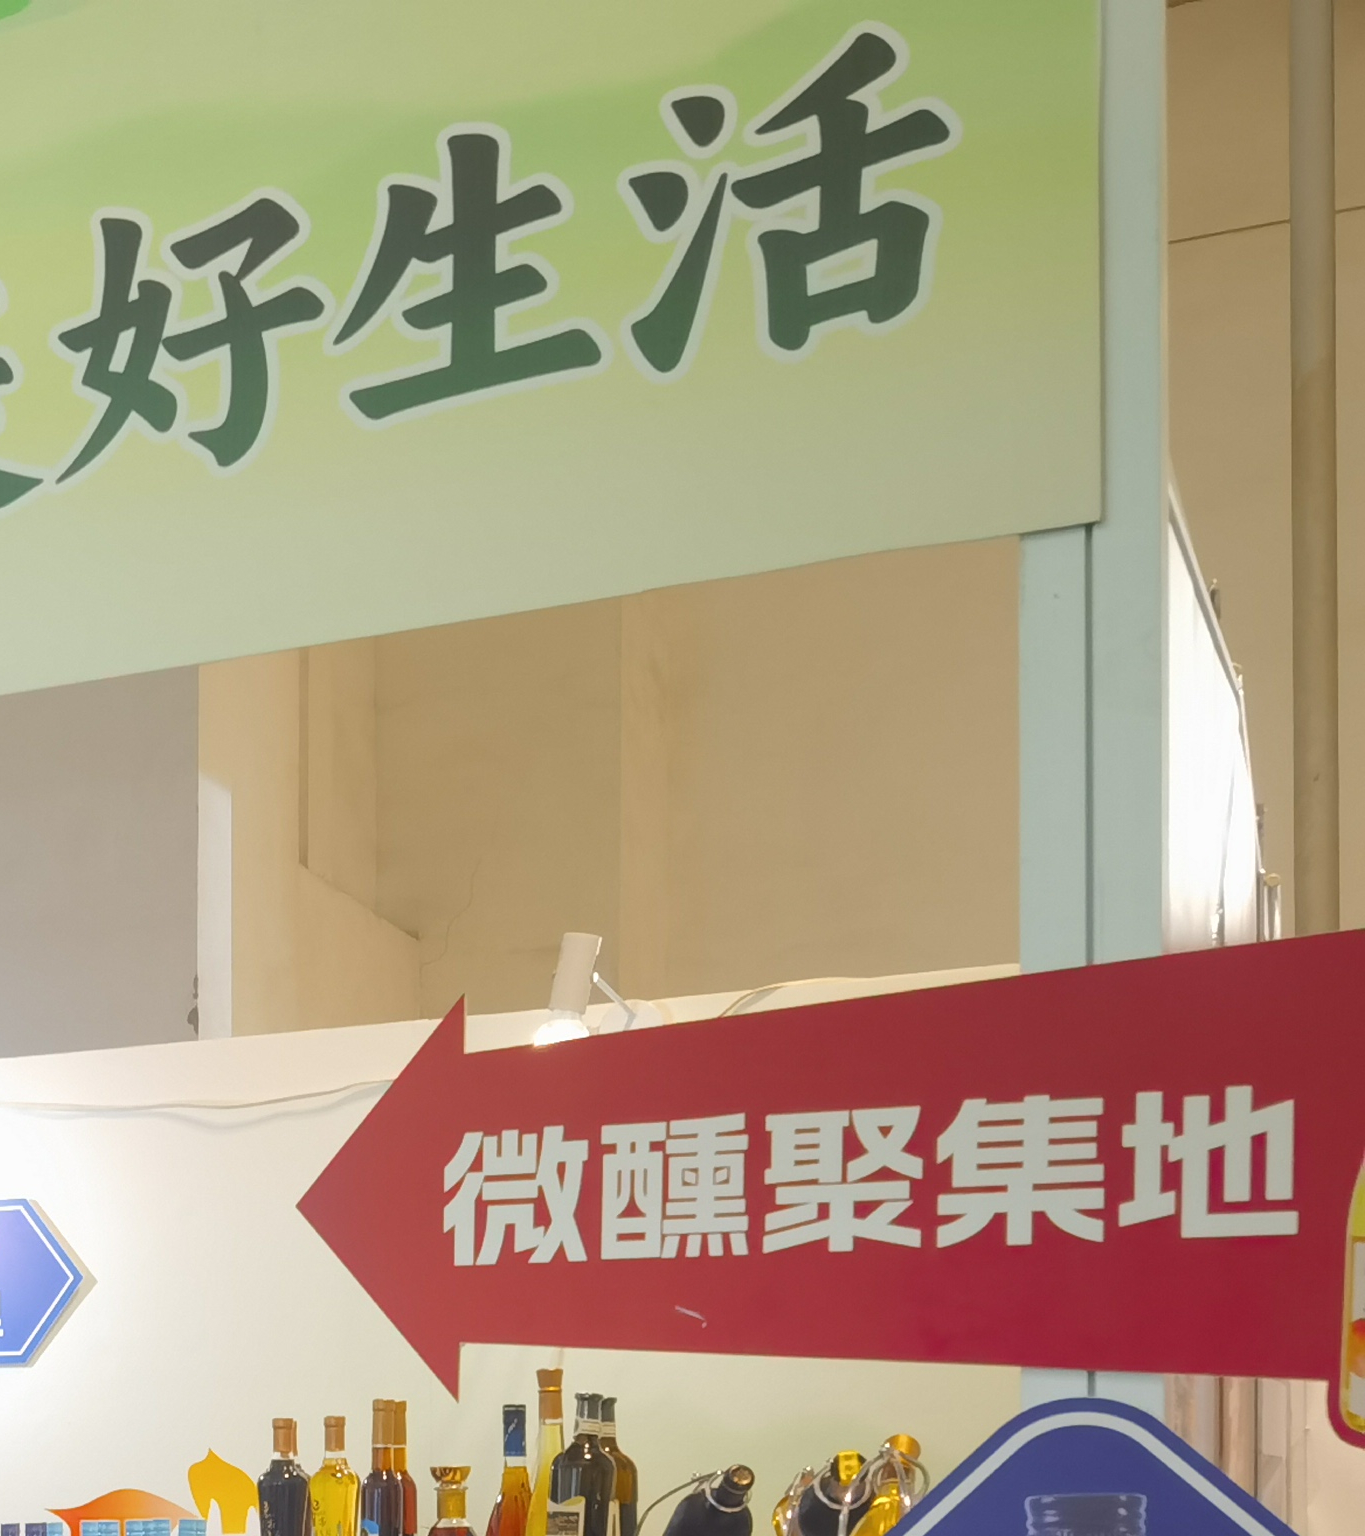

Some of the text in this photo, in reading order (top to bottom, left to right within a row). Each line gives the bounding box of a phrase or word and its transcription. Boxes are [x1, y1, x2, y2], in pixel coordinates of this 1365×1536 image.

[443, 1085, 1299, 1266] 微醺聚集地
